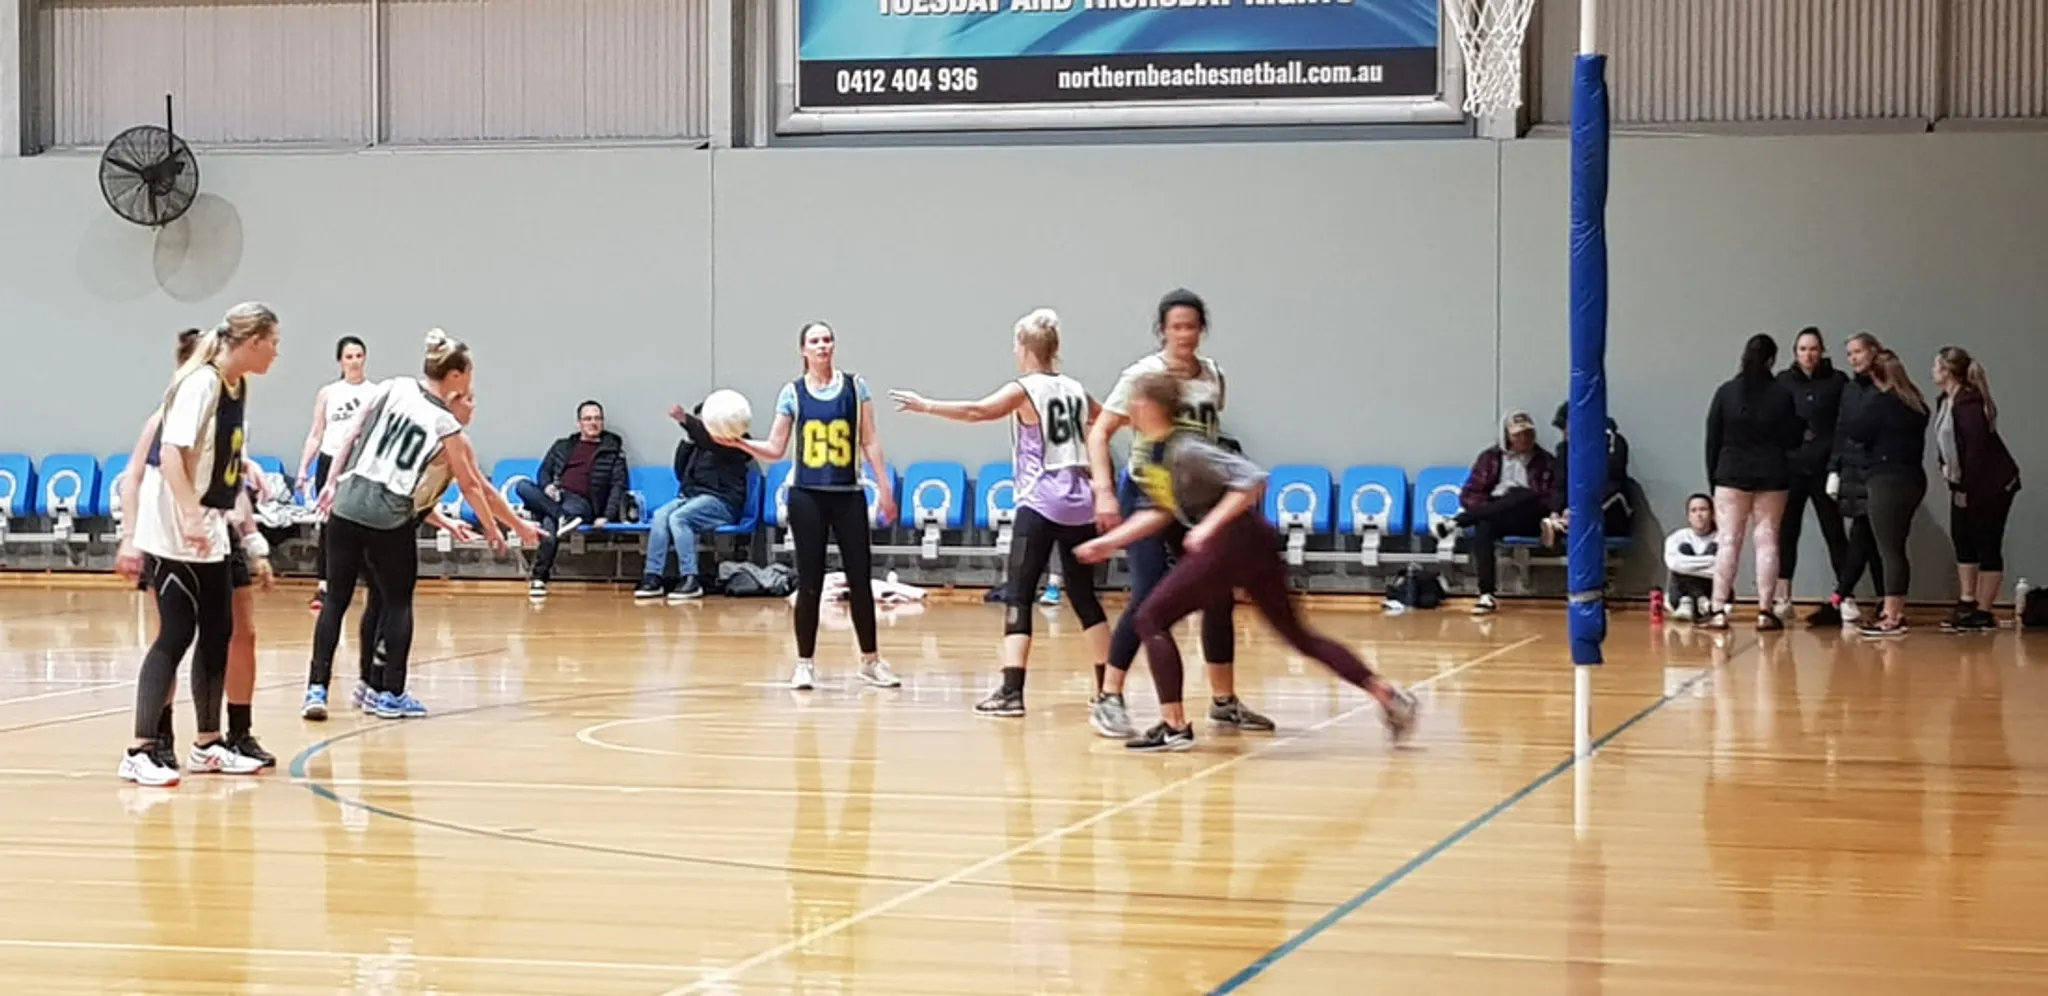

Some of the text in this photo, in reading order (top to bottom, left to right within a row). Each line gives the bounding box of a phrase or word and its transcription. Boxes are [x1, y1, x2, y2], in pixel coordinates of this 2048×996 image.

[836, 66, 978, 94] 0412 404 936
[1058, 61, 1383, 89] northernbeachesnetball.com.au
[1047, 395, 1085, 446] GK
[803, 418, 852, 469] GS
